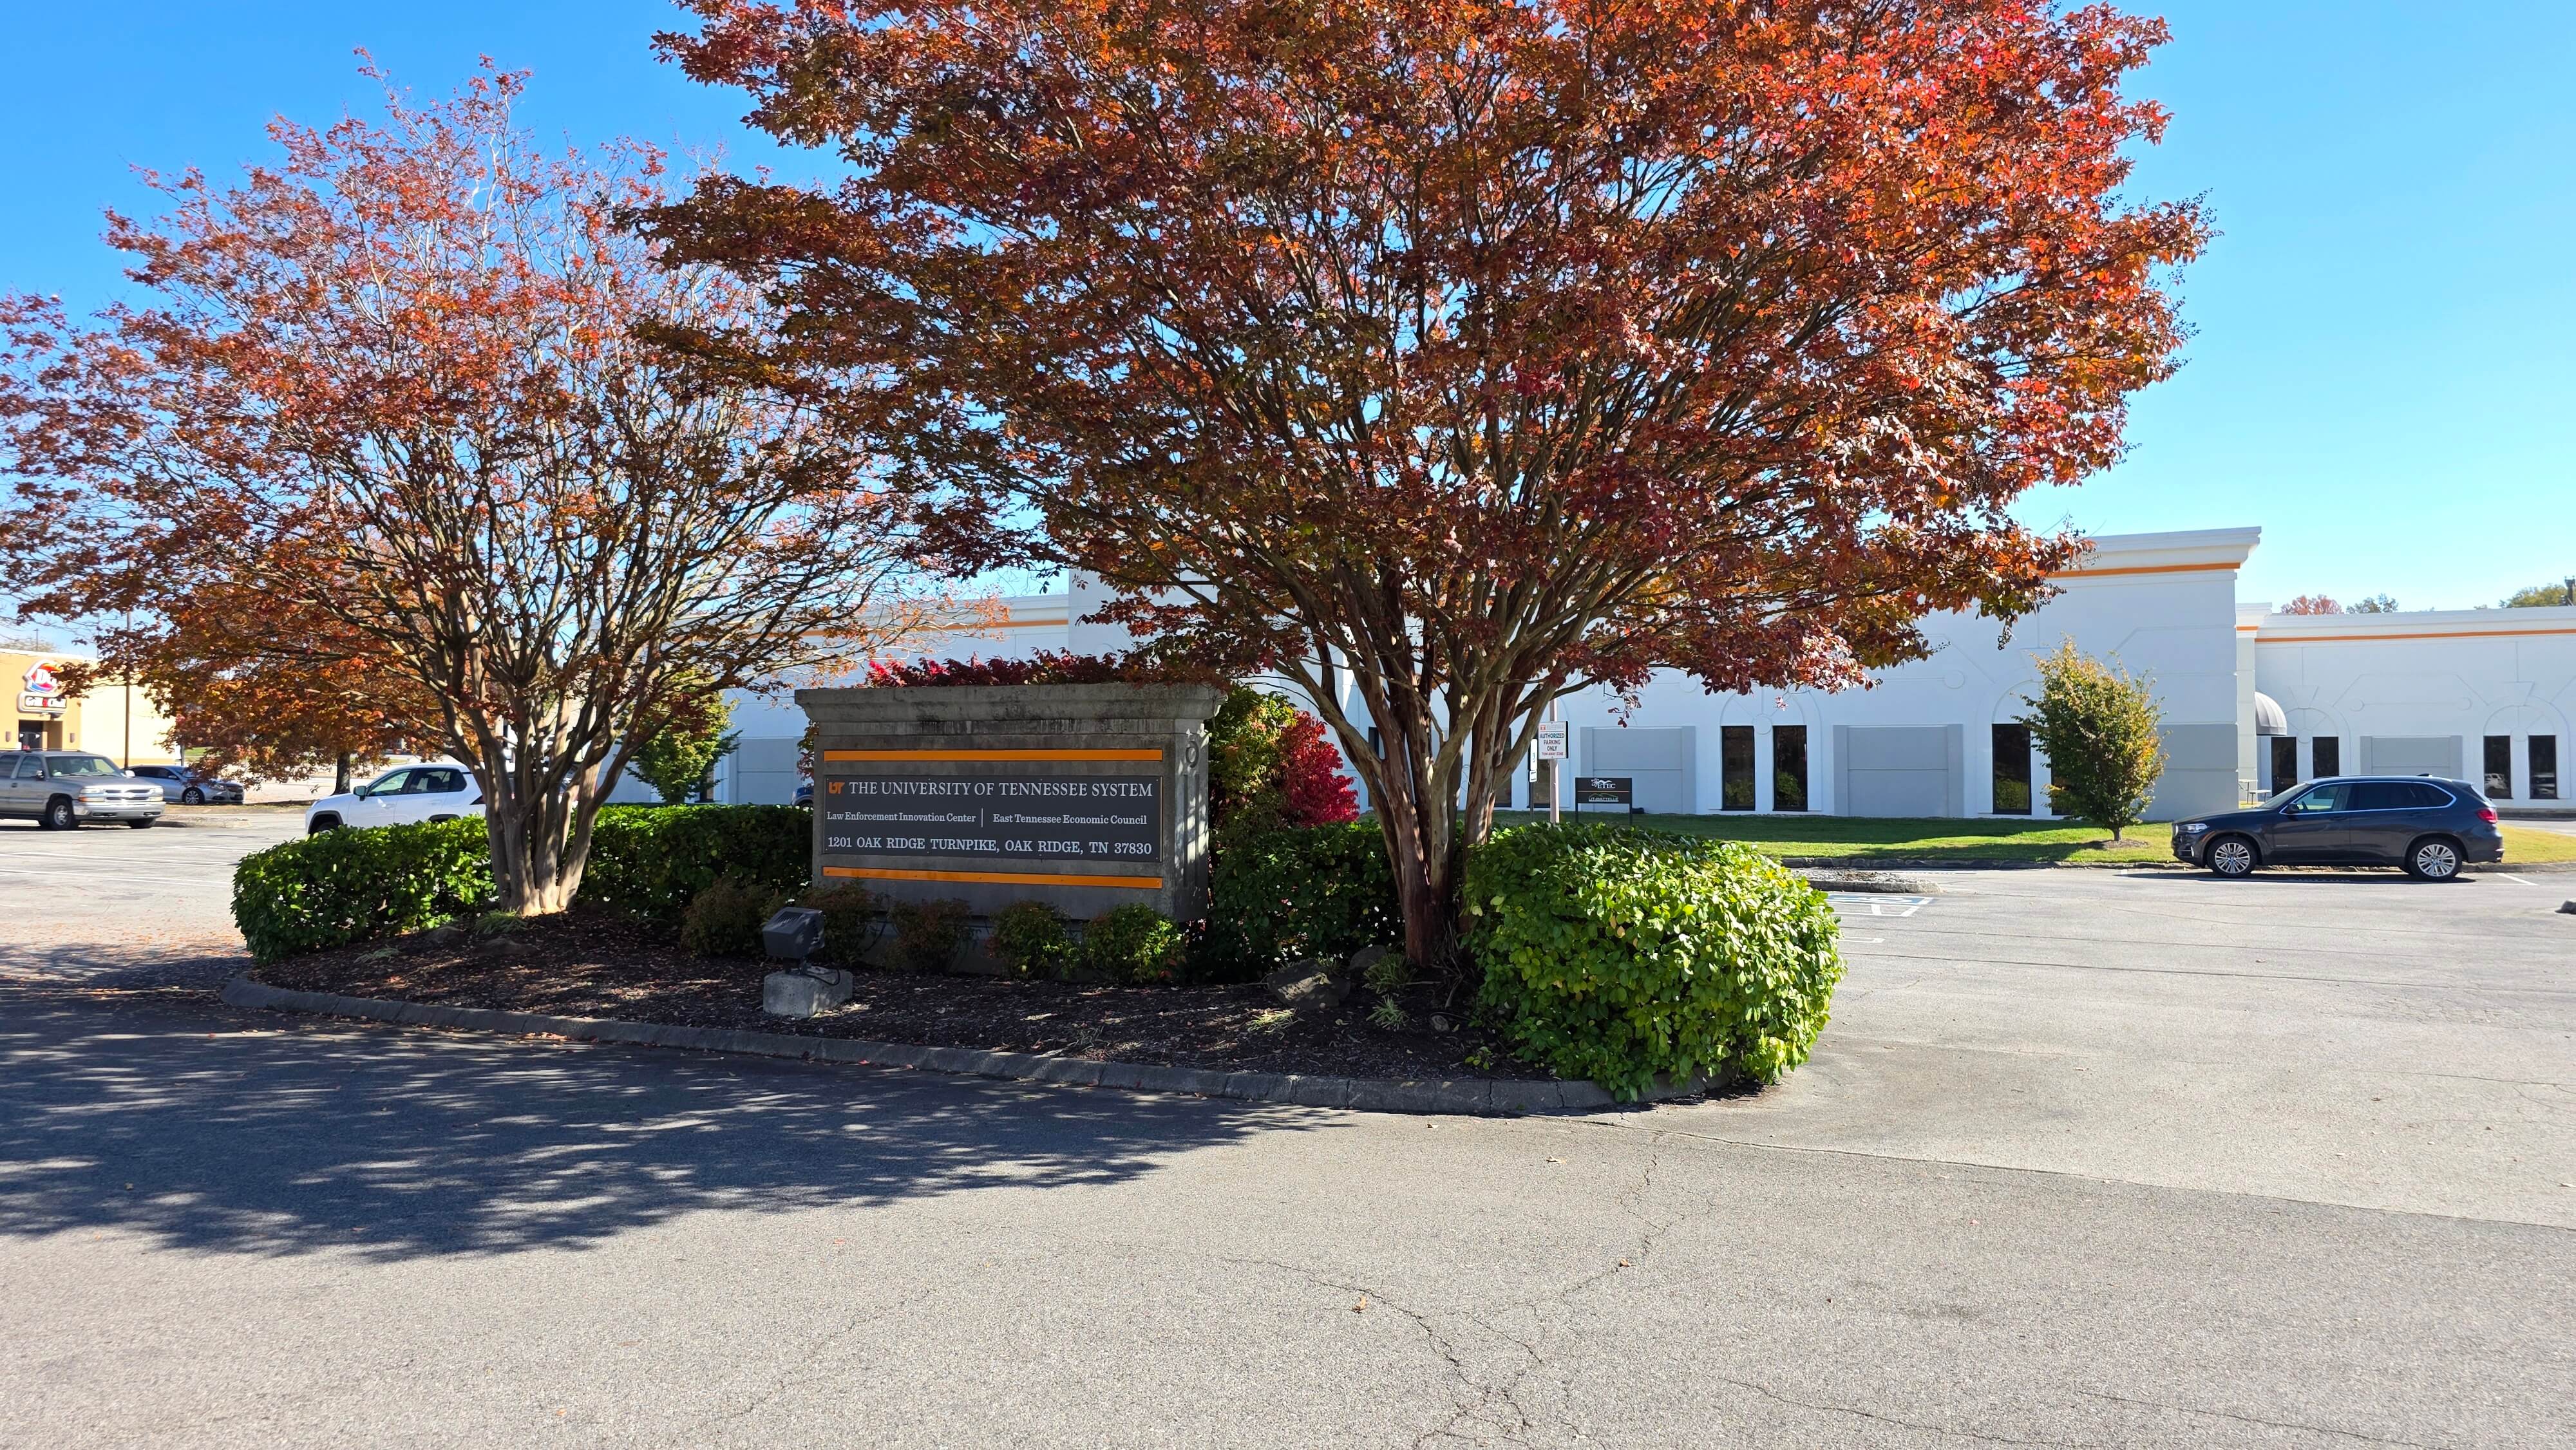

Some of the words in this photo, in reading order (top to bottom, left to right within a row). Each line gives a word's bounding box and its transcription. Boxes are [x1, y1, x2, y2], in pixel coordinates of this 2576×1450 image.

[828, 782, 845, 794] UT
[849, 782, 878, 795] THE
[880, 782, 971, 795] UNIVERSITY
[974, 782, 995, 796] OF
[999, 782, 1088, 796] TENNESSEE
[1092, 783, 1153, 797] SYSTEM
[826, 811, 844, 820] Law
[844, 811, 898, 821] Enforcement
[899, 813, 945, 822] Innovation
[946, 813, 976, 822] Center
[992, 814, 1013, 823] East
[1014, 814, 1062, 824] Tennessee
[1063, 814, 1109, 824] Economic
[1110, 815, 1148, 825] Council
[828, 837, 853, 847] 1201
[857, 837, 882, 848] OAK
[886, 838, 925, 849] RIDGE
[930, 838, 1000, 853] TURNPIKE,
[1005, 840, 1033, 852] OAK
[1037, 841, 1084, 855] RIDGE,
[1088, 842, 1109, 853] TN
[1114, 842, 1153, 854] 37830
